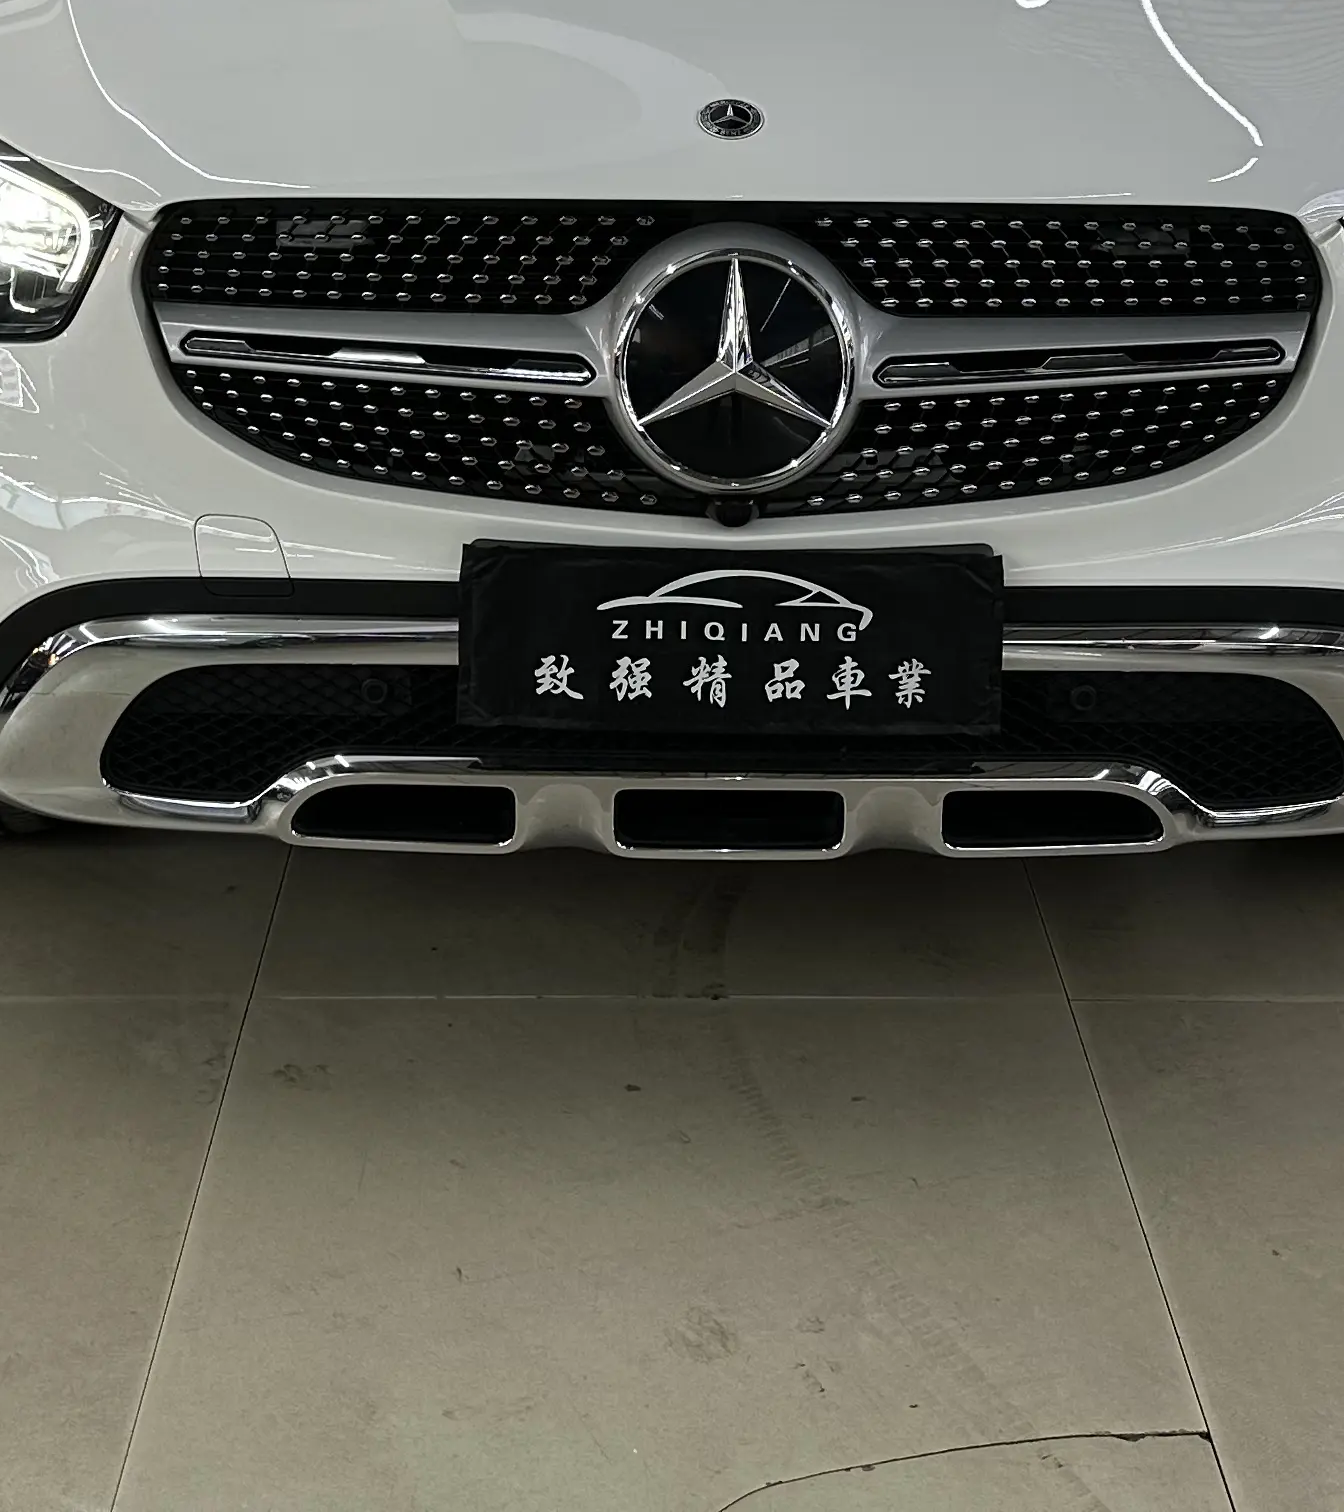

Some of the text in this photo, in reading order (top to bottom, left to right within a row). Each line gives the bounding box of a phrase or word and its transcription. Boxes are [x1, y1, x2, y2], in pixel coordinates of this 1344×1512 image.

[611, 620, 858, 643] ZHIQIANG
[533, 654, 932, 710] 致强精品車業
